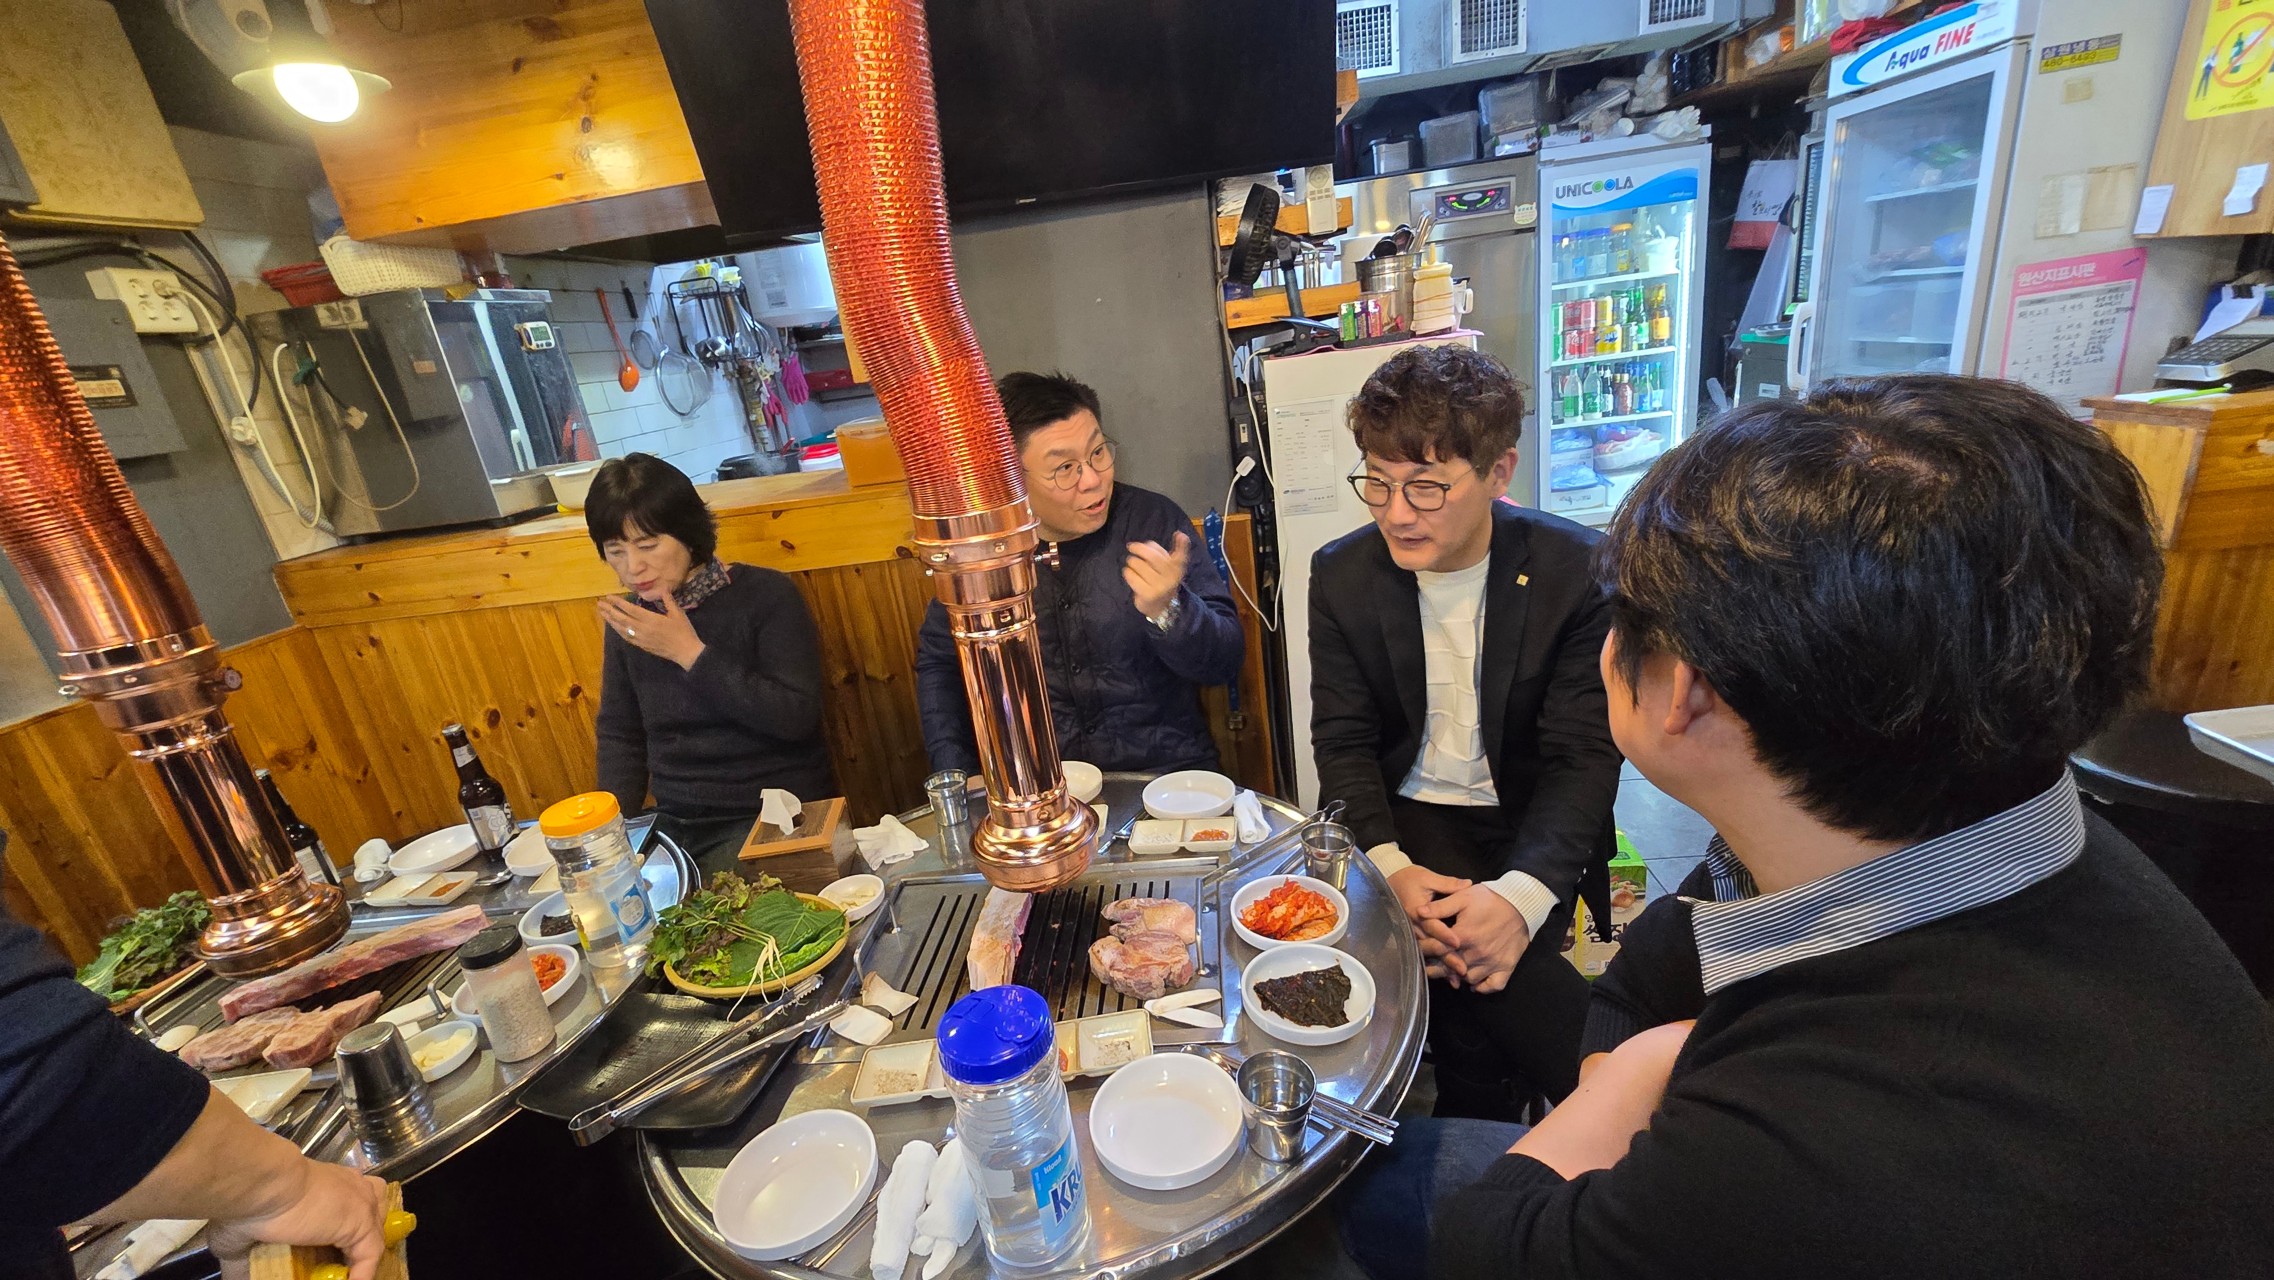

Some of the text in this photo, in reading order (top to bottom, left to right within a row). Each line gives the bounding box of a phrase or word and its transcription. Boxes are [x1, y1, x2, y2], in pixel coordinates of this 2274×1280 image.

[1885, 22, 1977, 72] Aqua FINE
[1555, 176, 1634, 199] UNICOOLA
